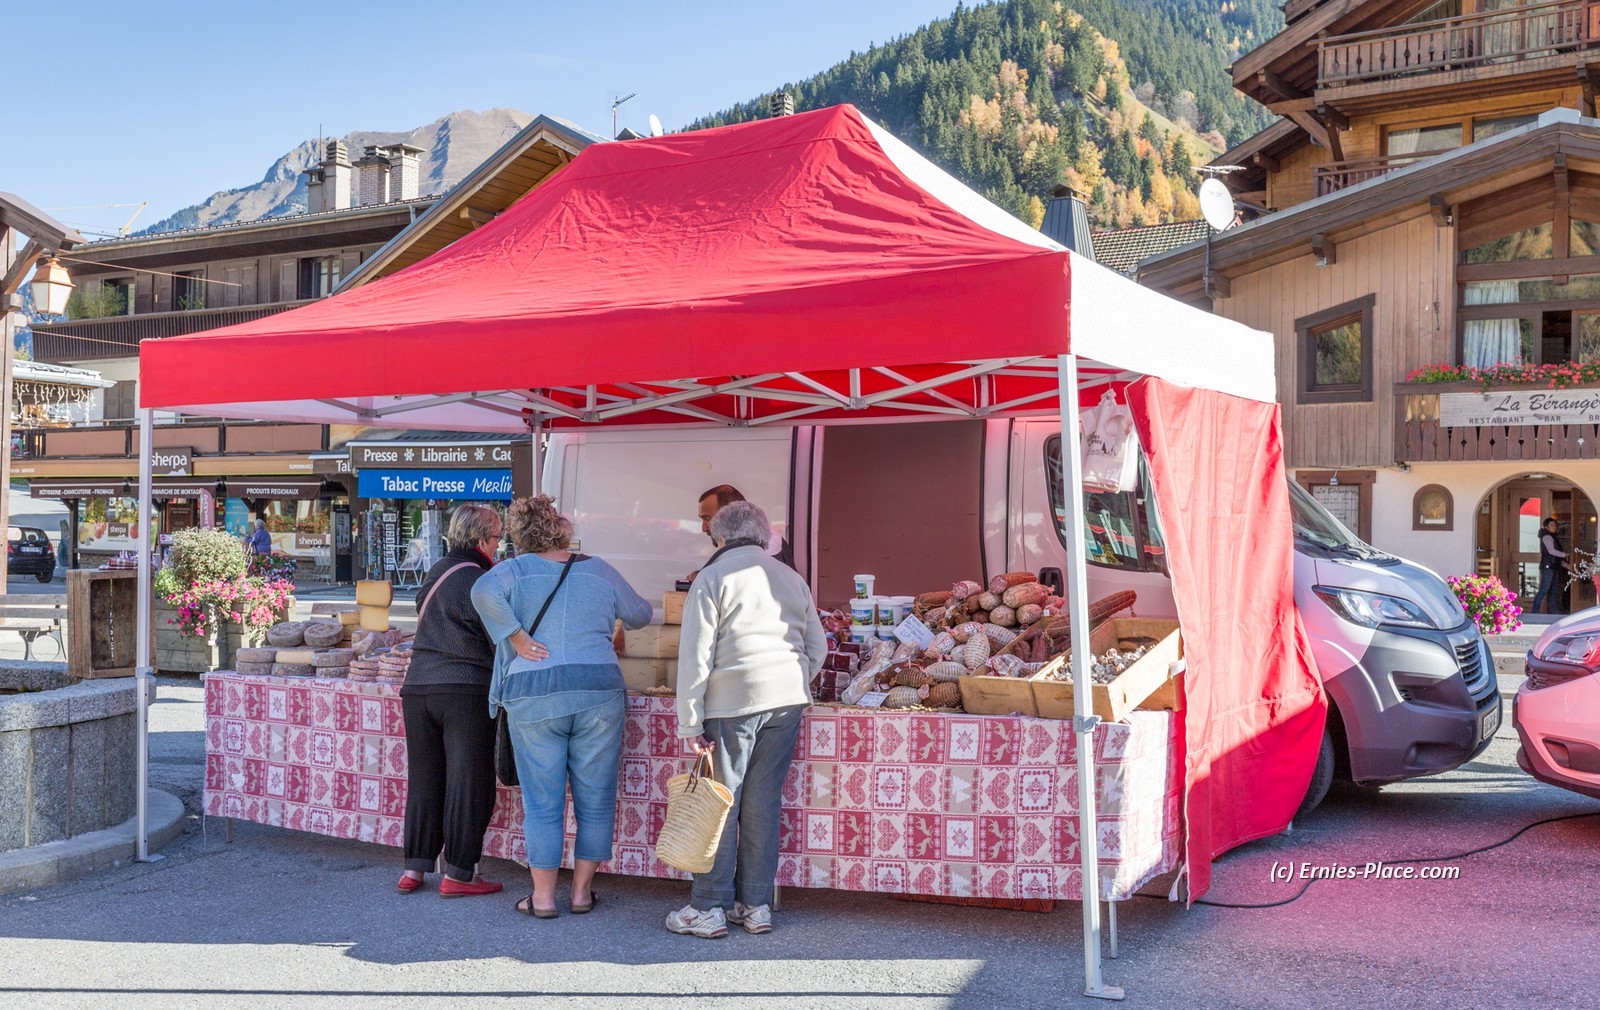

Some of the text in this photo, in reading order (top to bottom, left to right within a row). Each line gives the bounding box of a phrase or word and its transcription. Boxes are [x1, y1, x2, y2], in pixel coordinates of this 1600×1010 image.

[1494, 395, 1520, 412] La
[152, 452, 187, 468] sherpa
[364, 448, 398, 462] Presse
[422, 448, 468, 462] Librairie
[382, 476, 418, 492] Tabac
[423, 477, 465, 492] Presse
[110, 525, 126, 534] sherpa
[298, 537, 322, 545] sherpa
